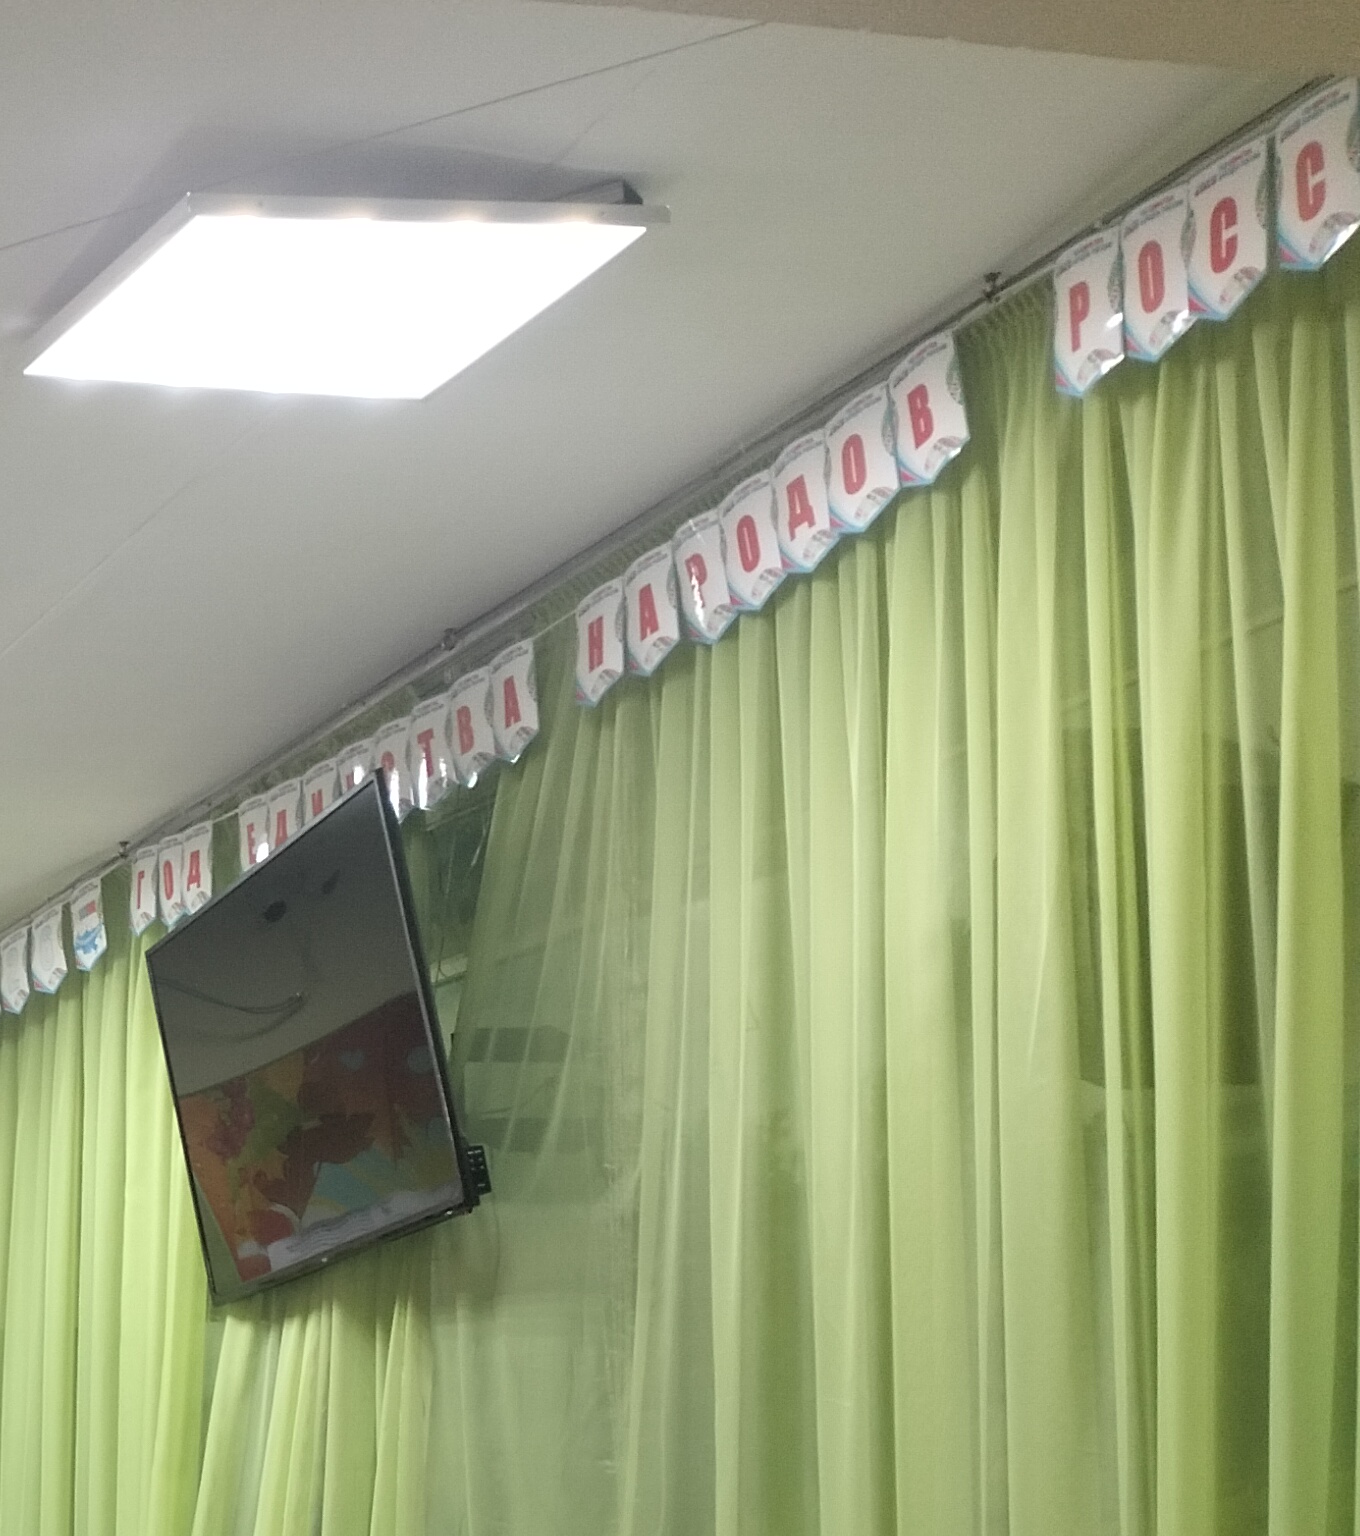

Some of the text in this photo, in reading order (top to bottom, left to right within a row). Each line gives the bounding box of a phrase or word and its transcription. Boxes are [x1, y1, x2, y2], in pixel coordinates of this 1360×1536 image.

[137, 849, 202, 910] ГОД
[587, 383, 935, 674] НАРОДОВ
[1068, 140, 1327, 354] РОСС
